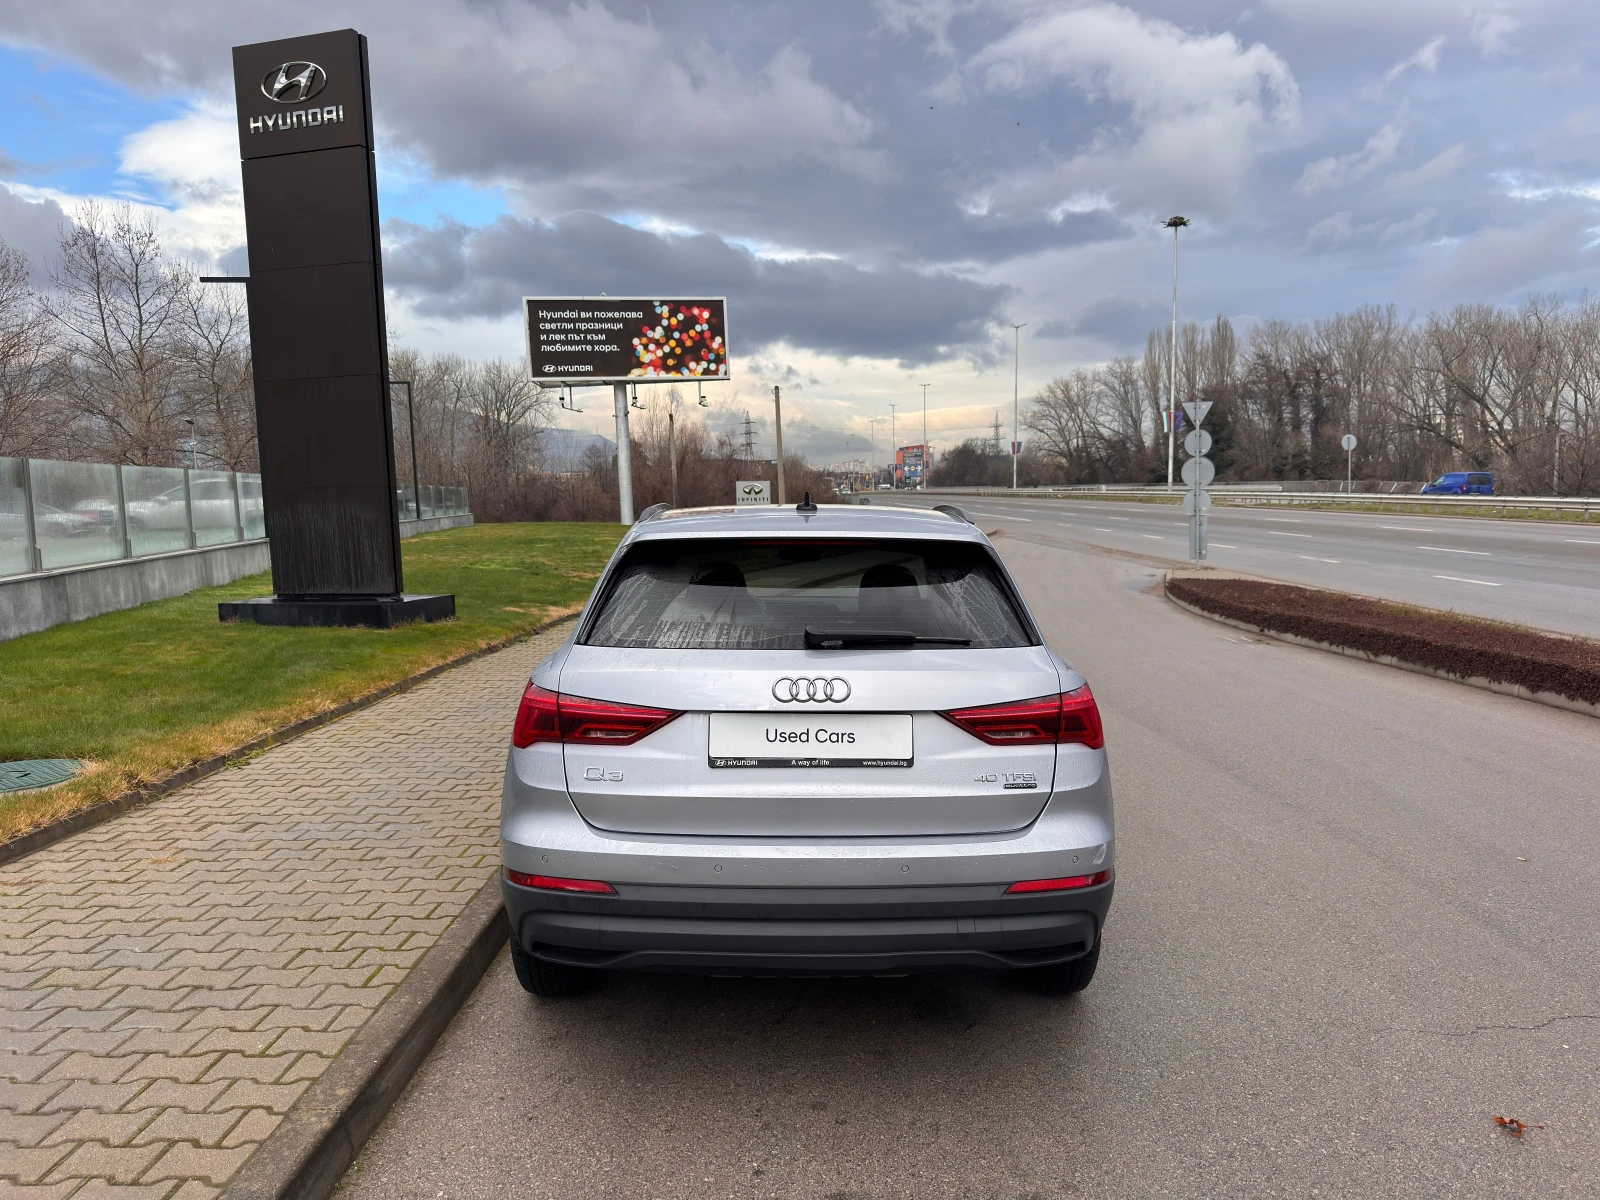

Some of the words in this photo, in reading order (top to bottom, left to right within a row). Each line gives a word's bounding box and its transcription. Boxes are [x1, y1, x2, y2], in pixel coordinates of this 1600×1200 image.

[249, 104, 344, 134] HYUNDAI
[538, 309, 578, 320] Hyundai
[580, 311, 593, 319] ви
[594, 311, 643, 319] пожелава
[539, 322, 574, 330] светли
[575, 322, 623, 331] празници
[540, 333, 547, 341] и
[548, 333, 567, 341] лек
[568, 333, 585, 341] път
[586, 333, 606, 341] към
[541, 343, 592, 352] любимите
[594, 344, 620, 353] хора.
[765, 728, 810, 743] Used
[814, 728, 856, 744] Cars
[583, 765, 624, 782] Q3
[973, 773, 998, 783] 40
[1001, 772, 1037, 783] TFSI
